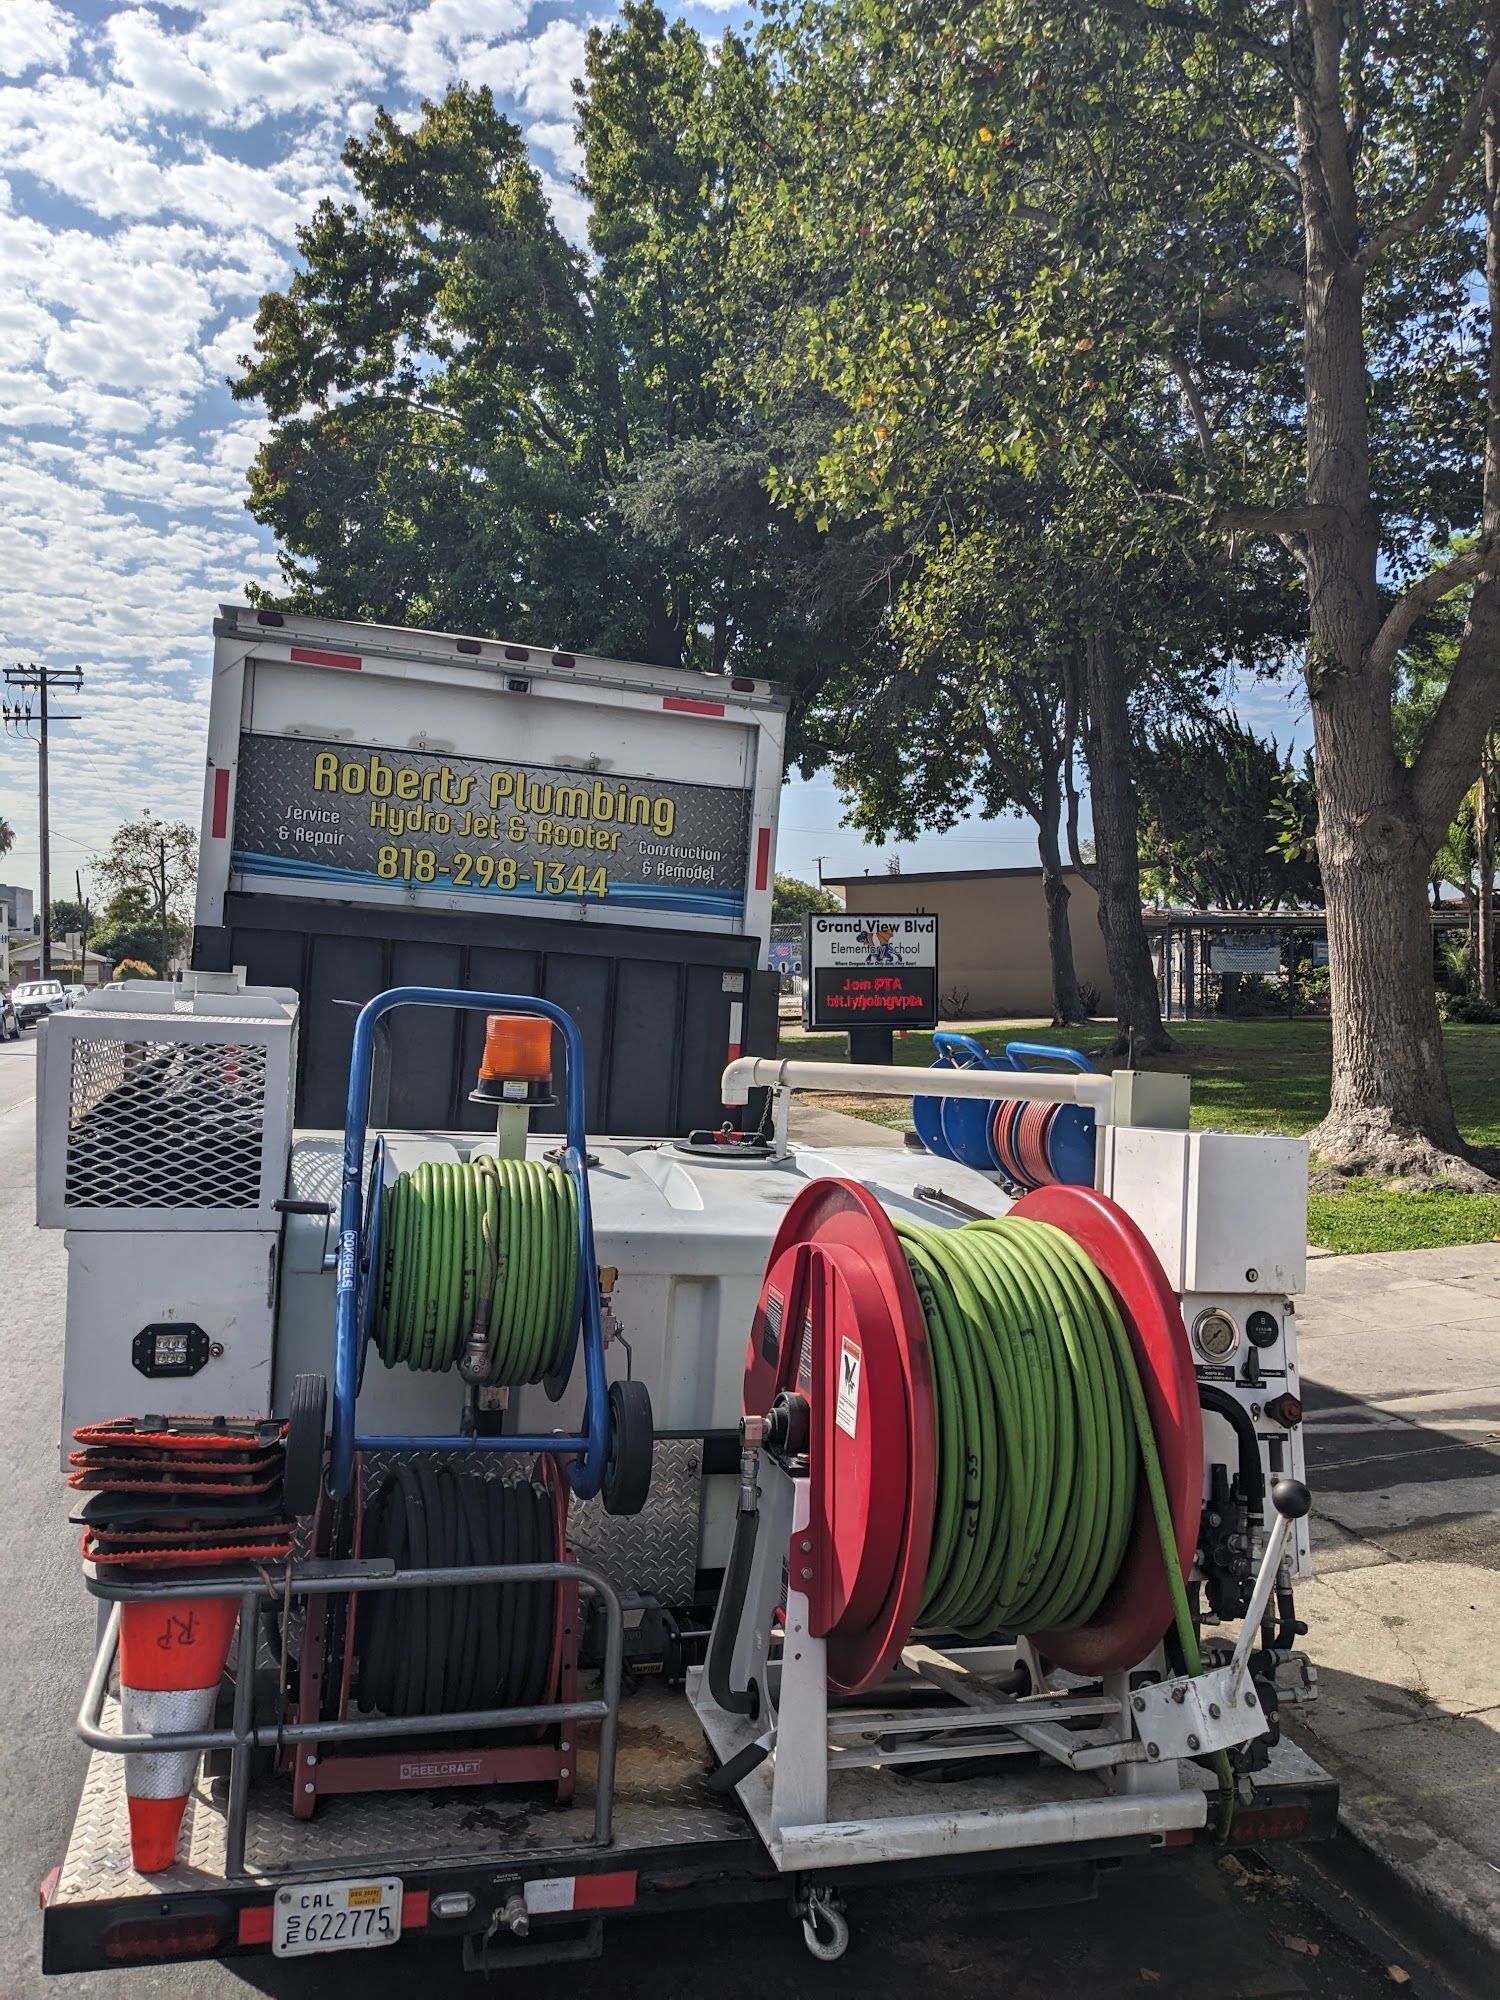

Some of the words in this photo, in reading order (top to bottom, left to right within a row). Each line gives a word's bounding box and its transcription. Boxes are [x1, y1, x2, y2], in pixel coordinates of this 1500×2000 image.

[313, 752, 475, 805] Roberts
[489, 771, 676, 837] Plumbing
[285, 805, 340, 824] Service
[278, 825, 290, 840] &
[295, 826, 345, 847] Repair
[369, 801, 450, 836] Hydro
[458, 811, 500, 839] Jet
[508, 815, 528, 842] &
[537, 818, 622, 851] Rooter
[638, 840, 722, 862] Construction
[377, 845, 609, 898] 818-298-1344
[642, 861, 652, 875] &
[657, 862, 715, 881] Remodel
[816, 919, 861, 933] Grand
[866, 919, 900, 933] View
[904, 919, 934, 933] Blvd
[831, 942, 886, 956] Elementary
[888, 942, 920, 954] School
[843, 978, 871, 991] Join
[874, 977, 902, 991] PTA
[411, 1762, 479, 1776] REELCRAFT
[301, 1894, 334, 1909] CAL
[305, 1906, 391, 1942] 622775
